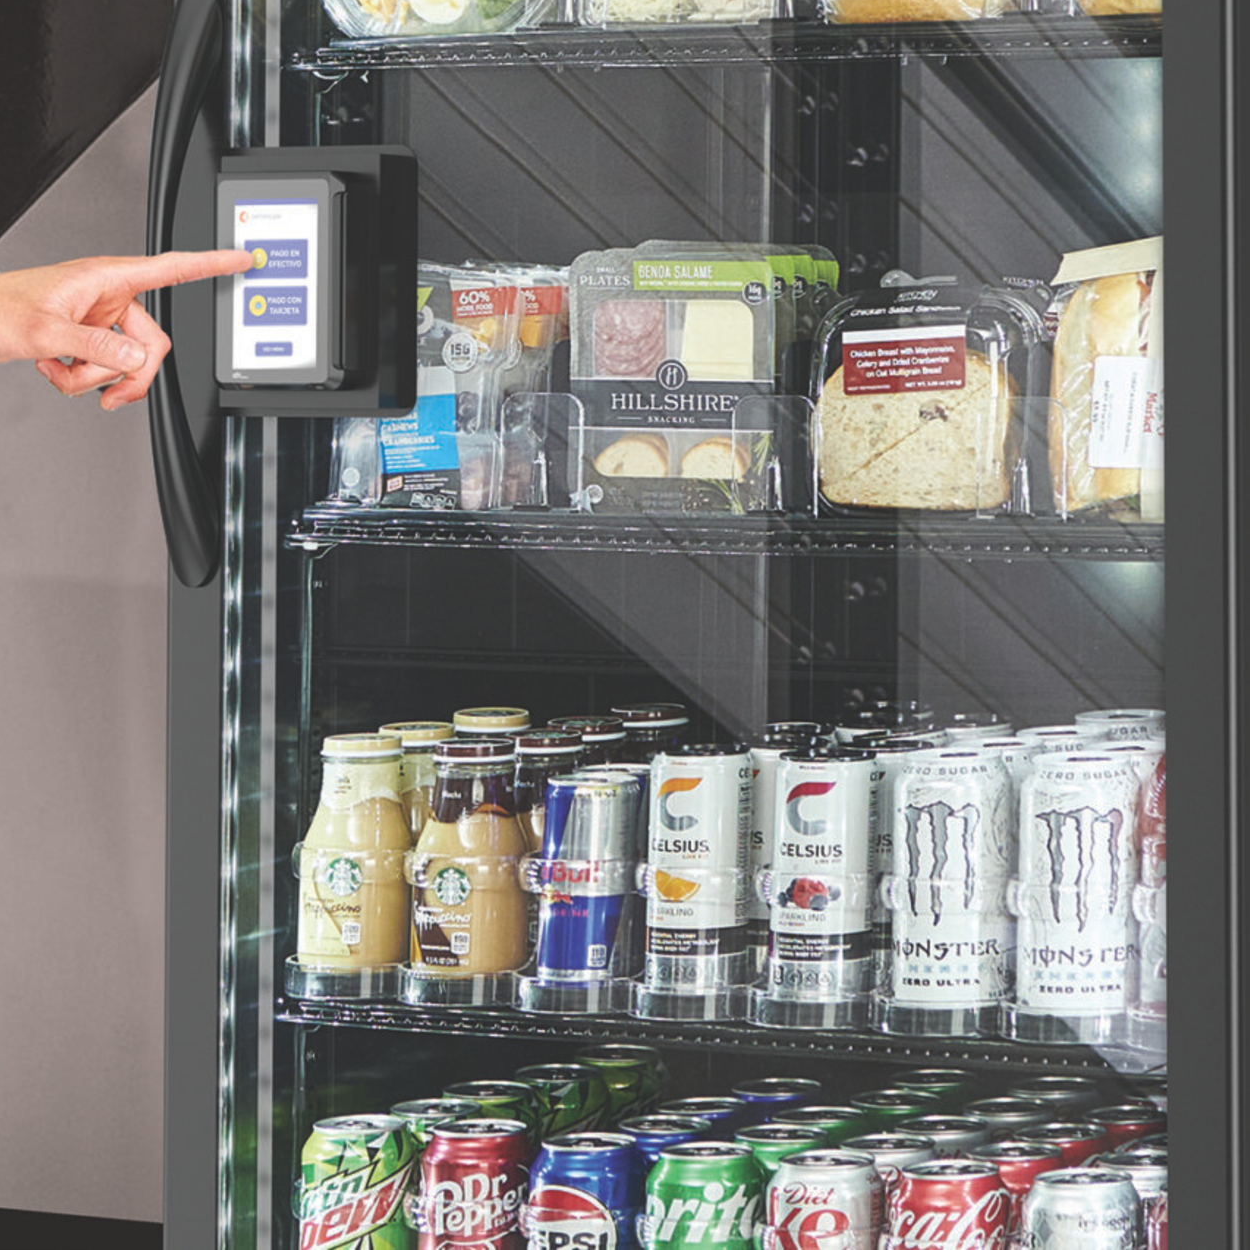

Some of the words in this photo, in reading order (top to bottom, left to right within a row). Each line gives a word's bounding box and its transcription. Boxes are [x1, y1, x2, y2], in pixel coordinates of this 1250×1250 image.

[638, 265, 671, 279] GENOA
[674, 265, 714, 279] SALAME
[579, 275, 631, 286] PLATES
[458, 290, 491, 305] 60%
[611, 392, 734, 412] HILLSHIRE
[647, 415, 696, 424] SNACKING
[780, 843, 843, 858] CELSIUS
[463, 1173, 508, 1204] Dr
[783, 1180, 835, 1205] Diet
[433, 1181, 529, 1238] Pepper
